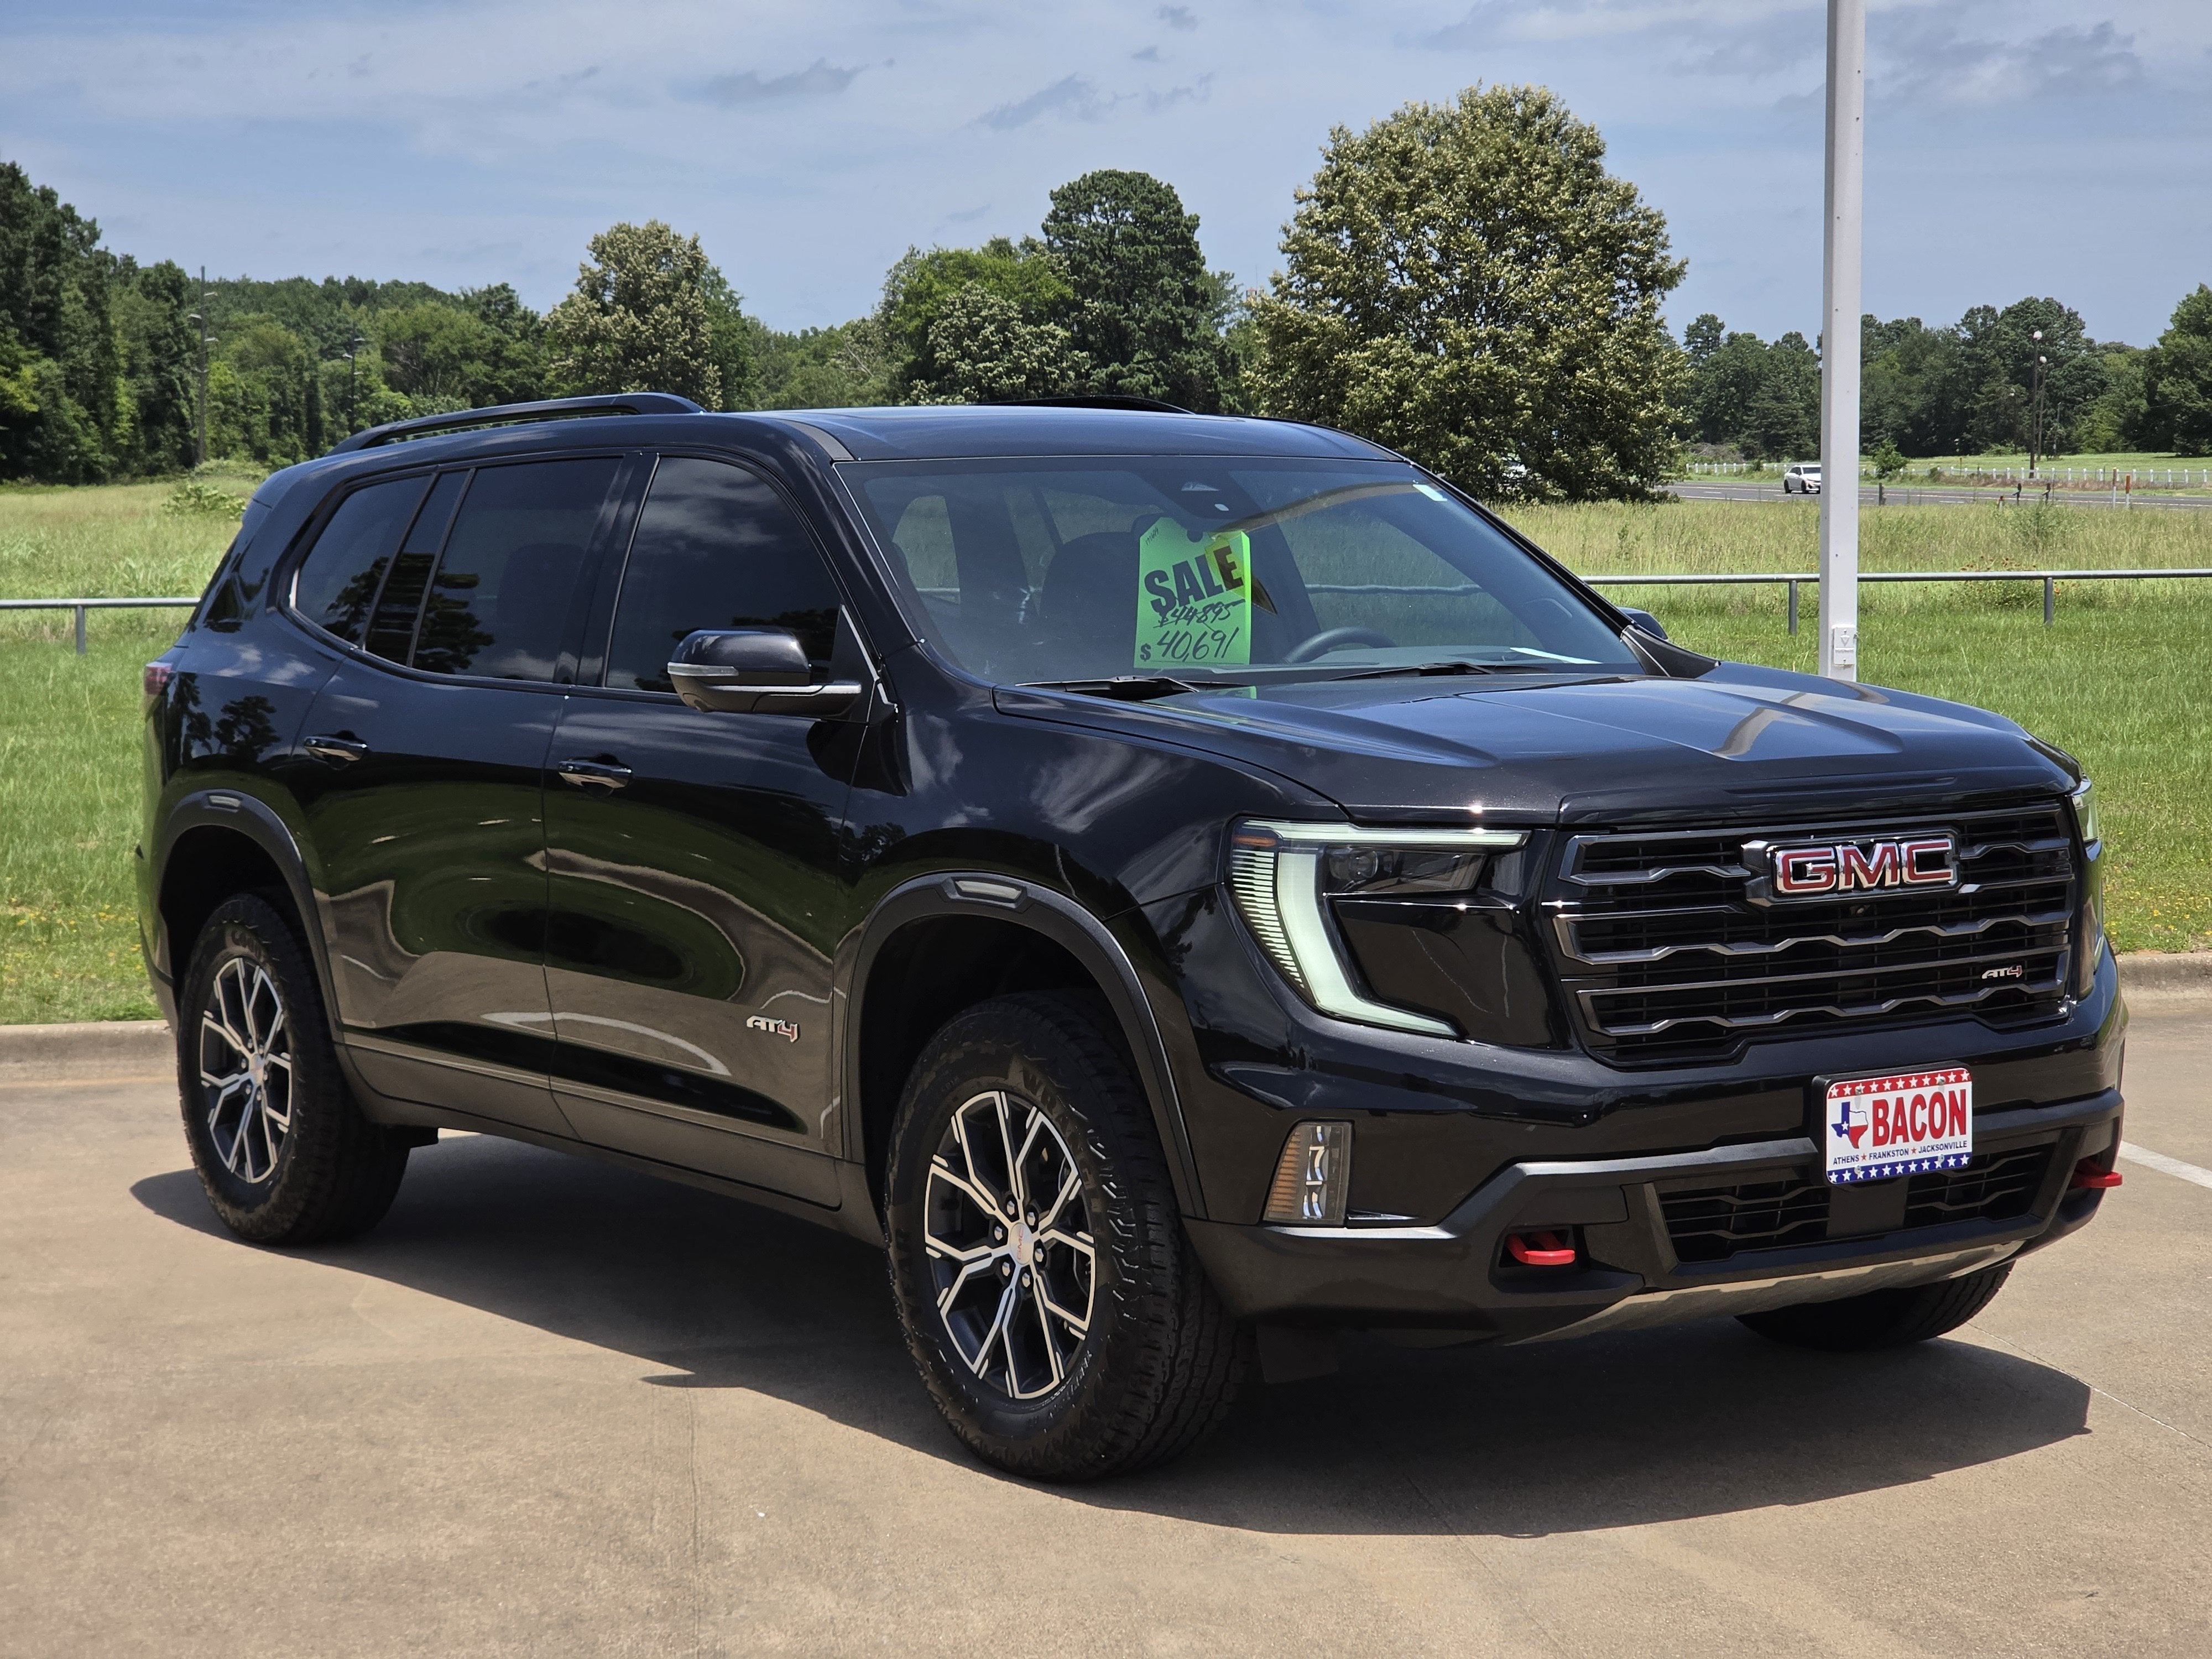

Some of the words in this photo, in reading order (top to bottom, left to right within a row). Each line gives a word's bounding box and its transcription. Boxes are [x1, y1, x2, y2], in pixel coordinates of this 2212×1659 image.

[1144, 545, 1244, 613] SALE
[1776, 838, 1953, 893] GMC
[1982, 965, 2022, 979] AT4
[747, 1015, 798, 1042] AT4
[1872, 1089, 1966, 1147] BACON
[1833, 1154, 1860, 1165] ATHENS
[1869, 1148, 1909, 1160] FRANKSTON
[1918, 1140, 1968, 1154] JACKSONVILLE
